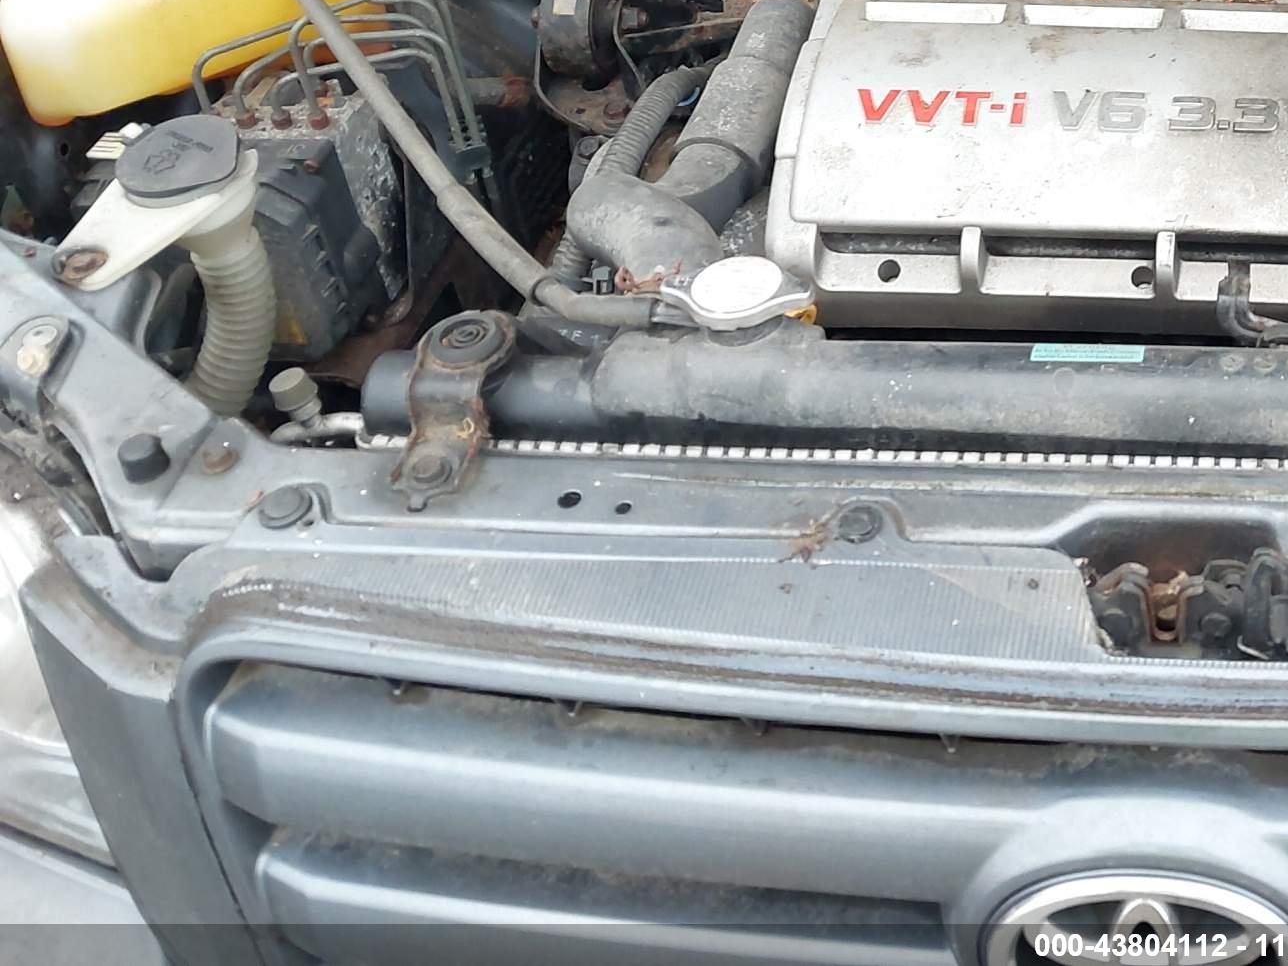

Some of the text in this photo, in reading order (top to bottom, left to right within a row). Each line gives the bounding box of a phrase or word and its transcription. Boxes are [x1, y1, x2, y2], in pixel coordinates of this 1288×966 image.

[857, 89, 1281, 133] VVT-i V6 3.3
